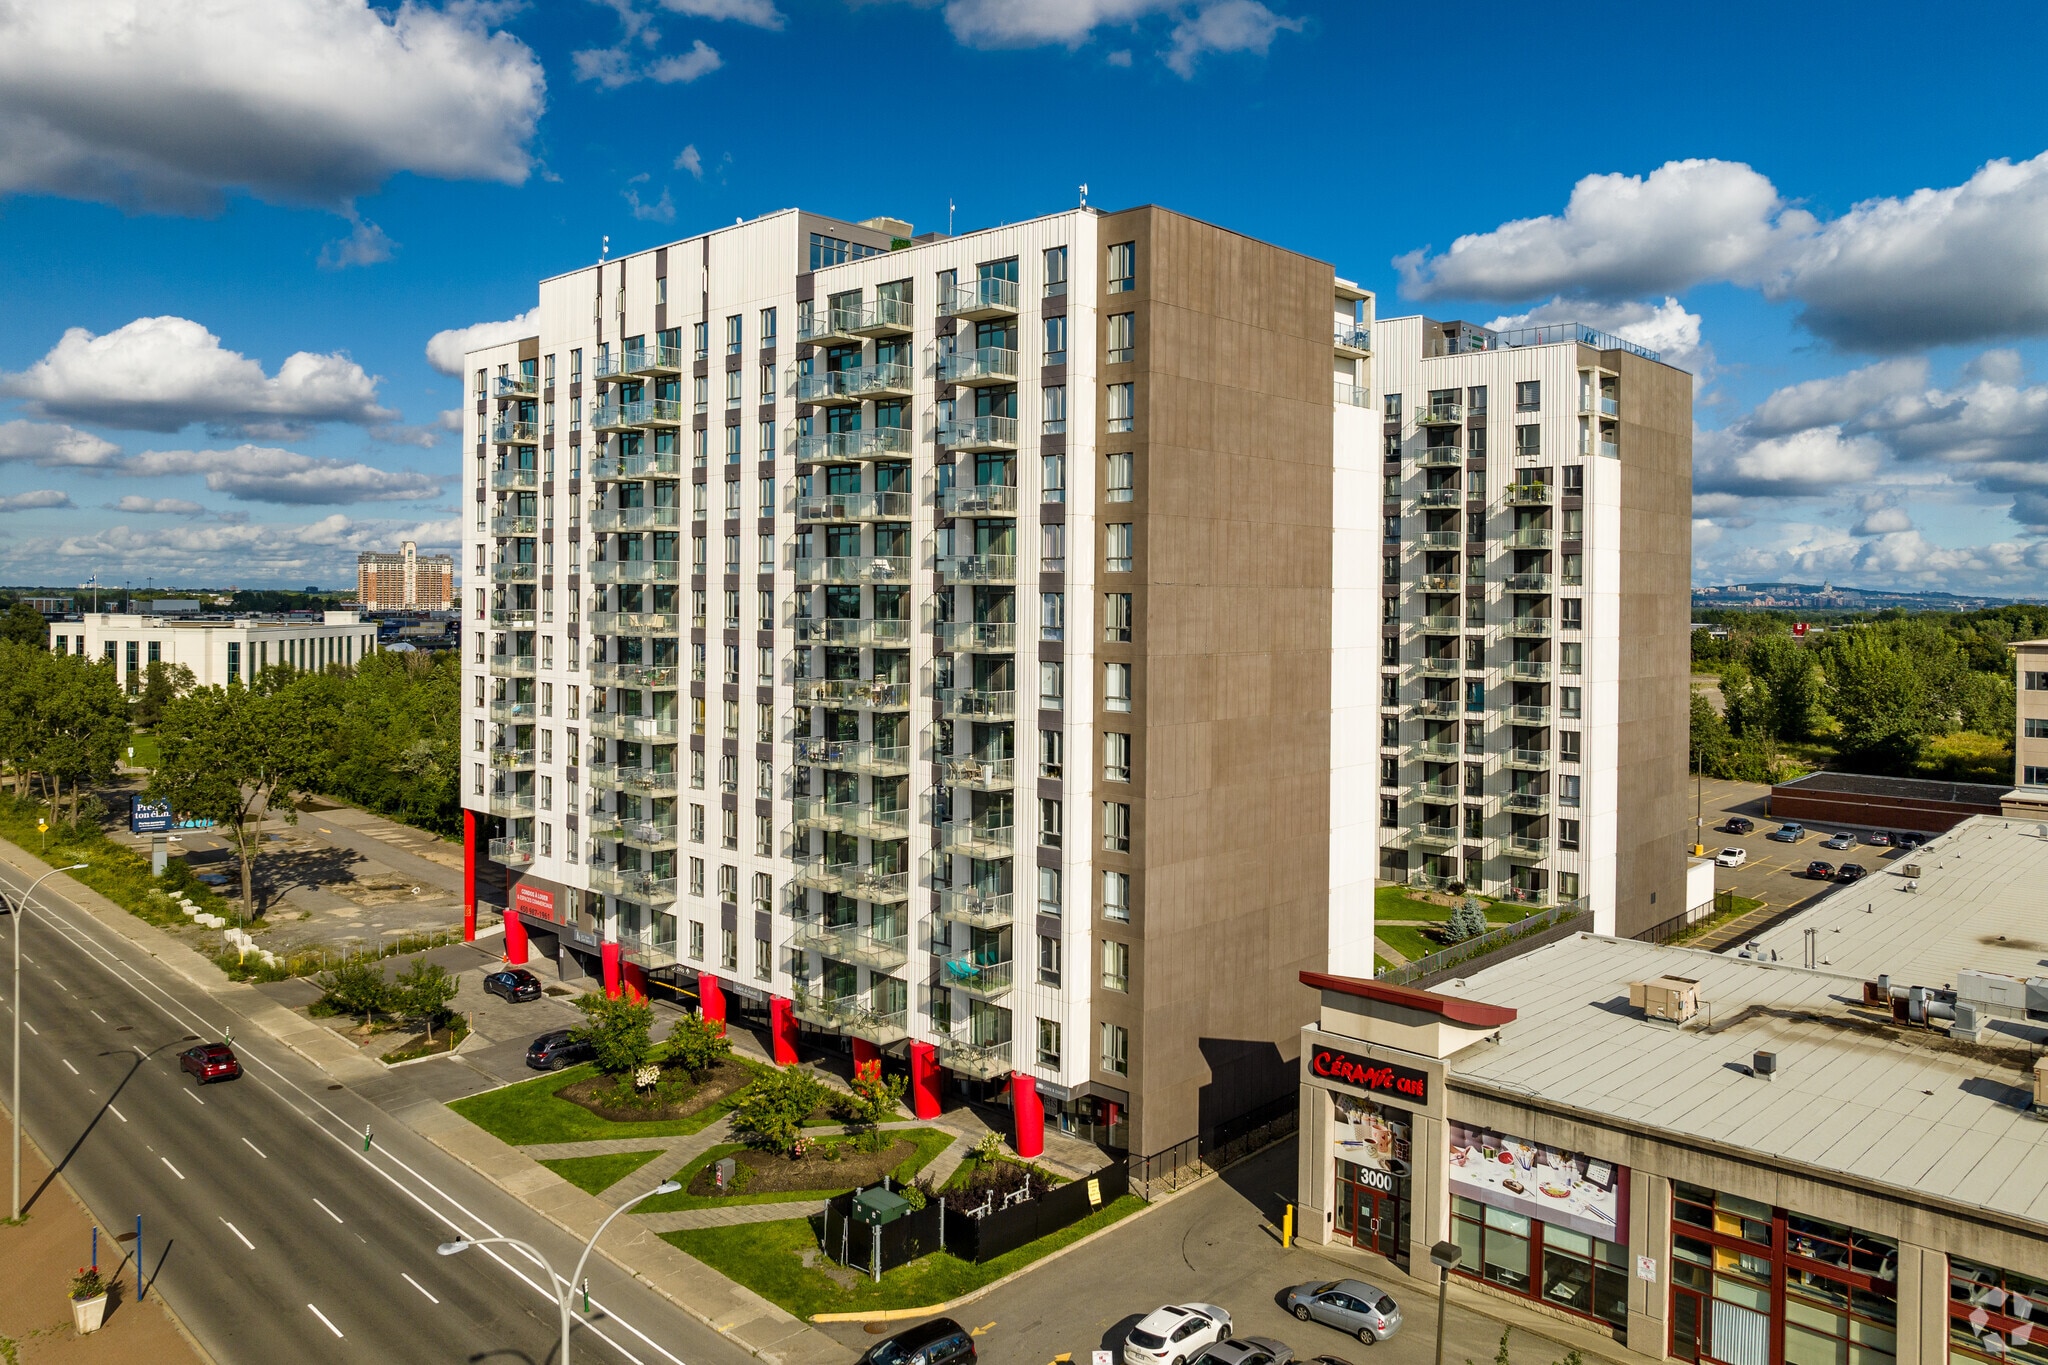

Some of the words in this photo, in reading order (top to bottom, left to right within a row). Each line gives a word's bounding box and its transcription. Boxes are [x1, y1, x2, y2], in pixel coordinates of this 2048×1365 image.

[136, 803, 168, 811] Pres
[538, 892, 549, 901] LOUER
[520, 905, 528, 913] 450
[1396, 1077, 1424, 1097] CAFÉ
[1360, 1167, 1393, 1191] 3000
